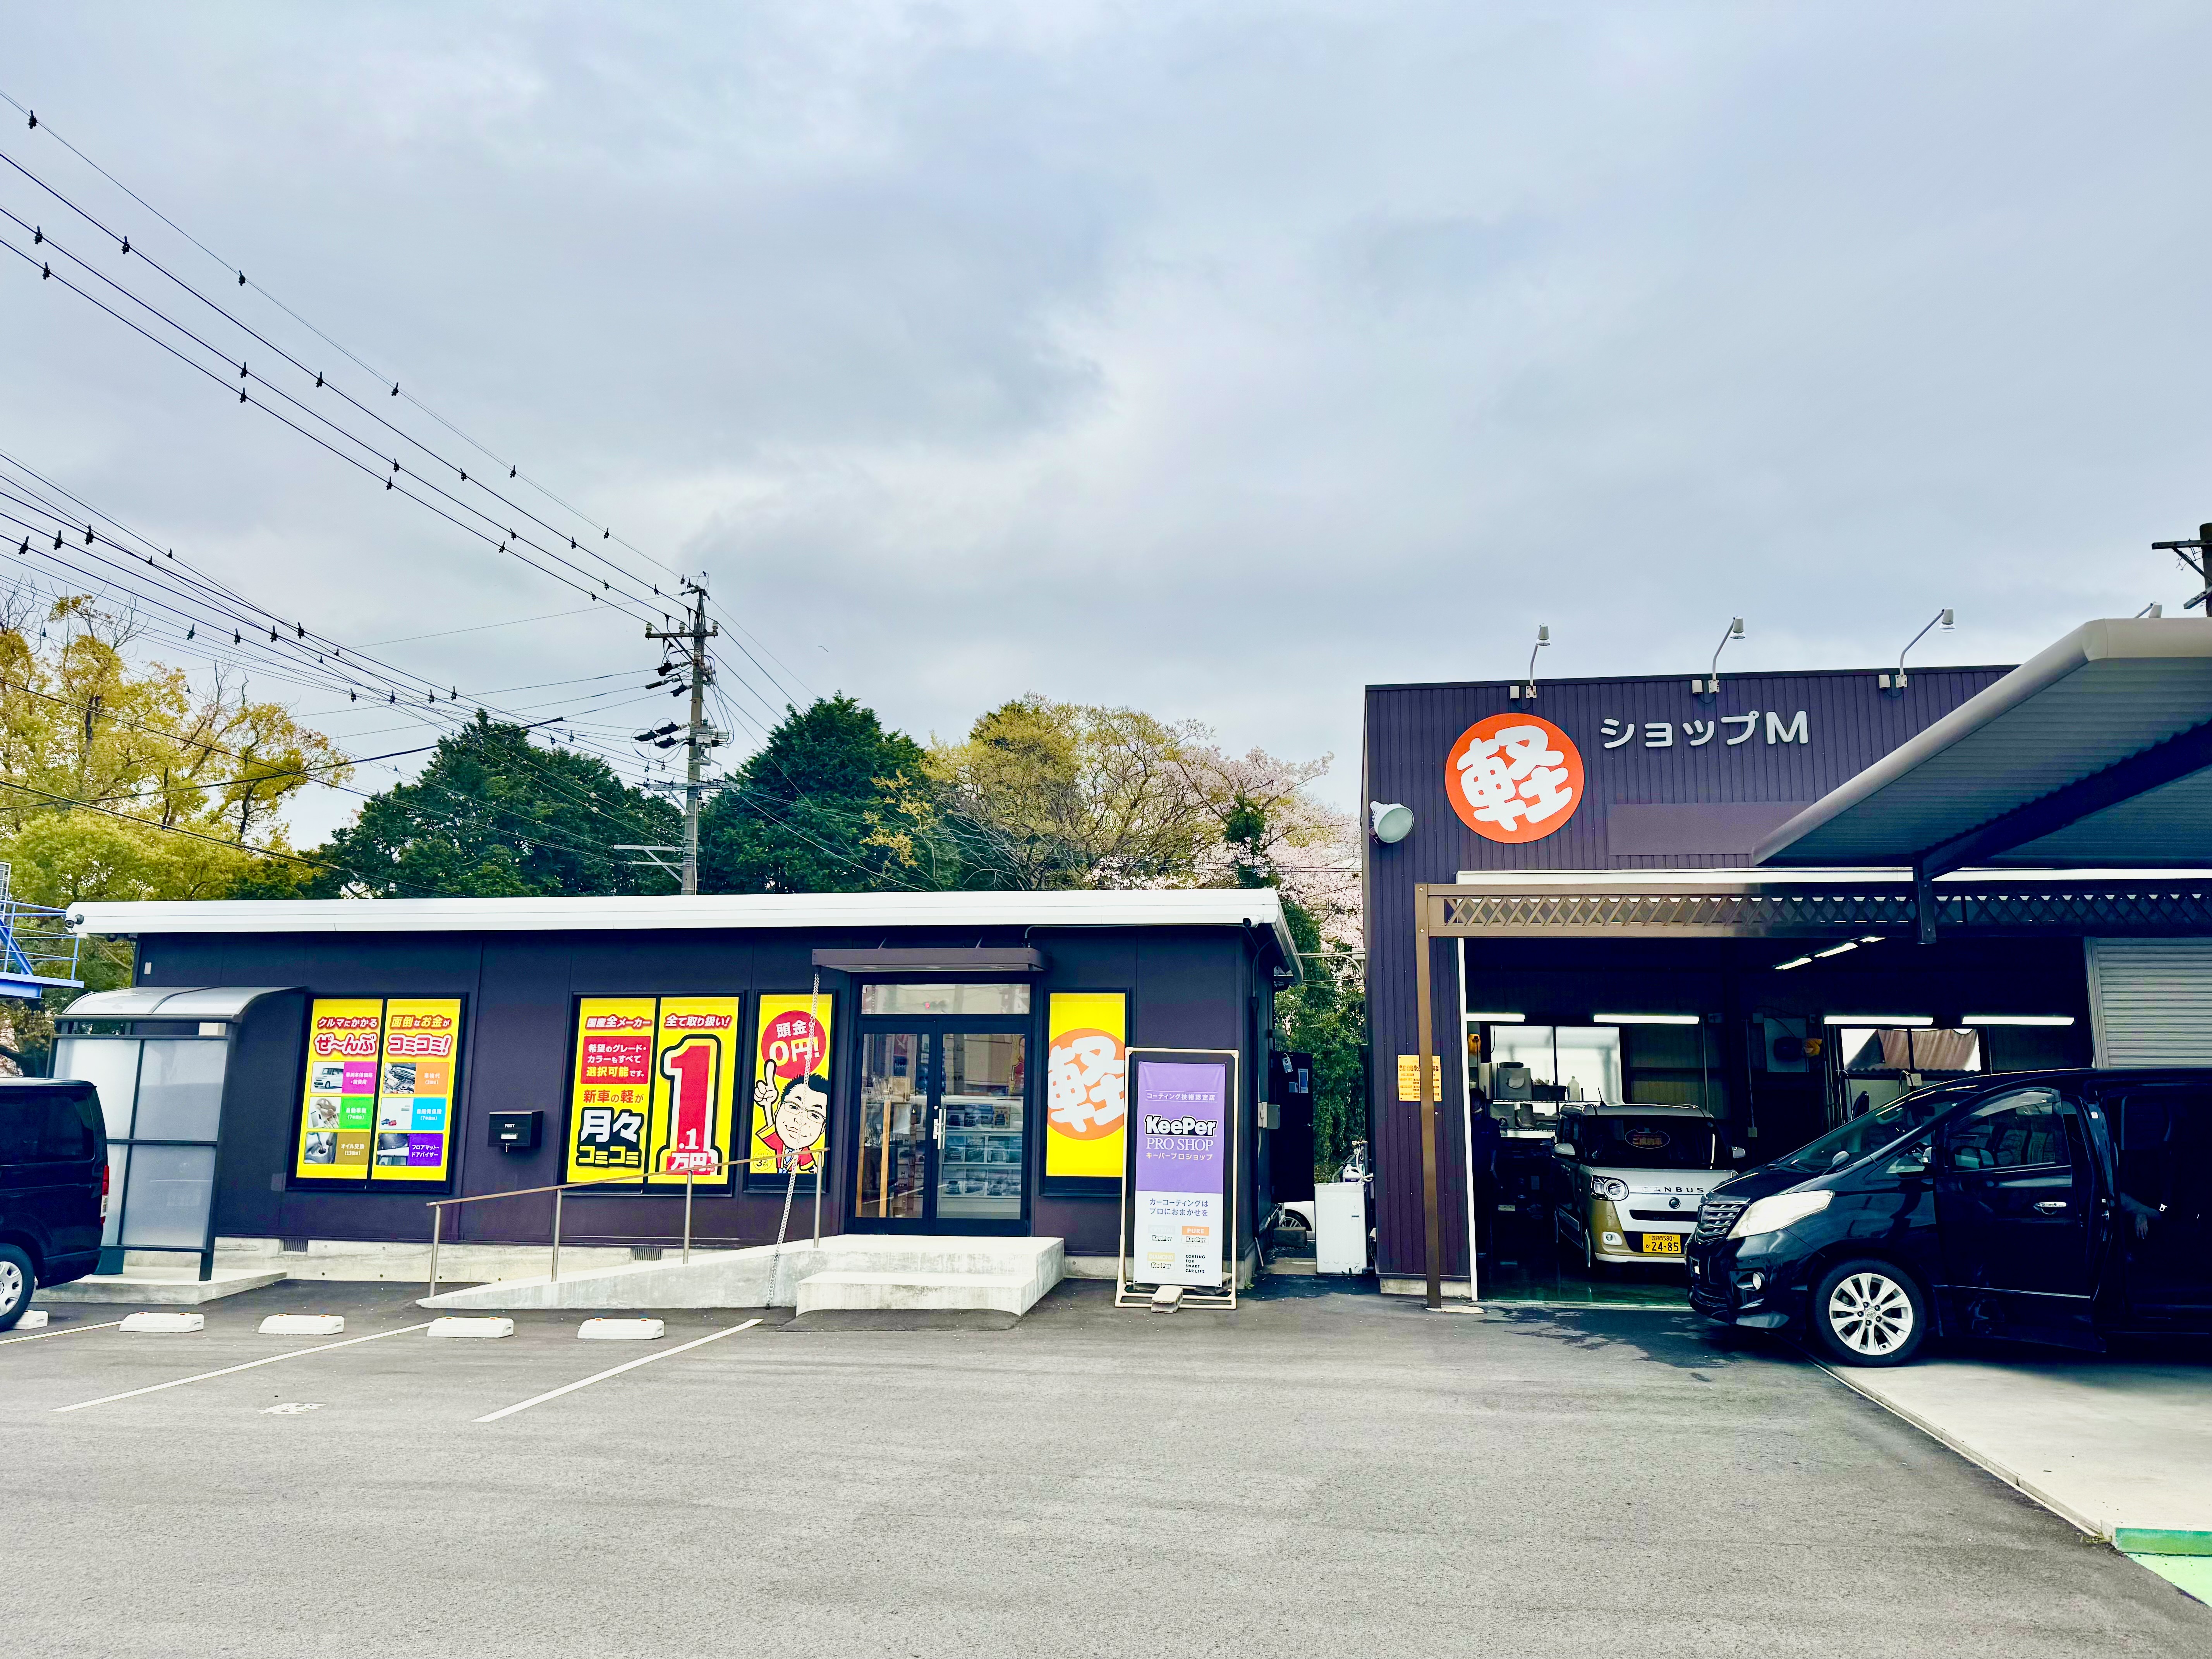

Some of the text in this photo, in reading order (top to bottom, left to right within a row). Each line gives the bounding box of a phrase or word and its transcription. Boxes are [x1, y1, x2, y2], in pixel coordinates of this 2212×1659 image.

[1600, 710, 1808, 749] ショップM
[1456, 724, 1573, 831] 軽
[319, 1018, 377, 1027] クルマにかかる
[392, 1016, 450, 1027] 面倒なお金が
[586, 1015, 651, 1028] 国産全メーカー
[665, 1015, 730, 1027] 全て取り扱い!
[776, 1019, 807, 1039] 頭金
[389, 1036, 450, 1054] コミコミ!
[588, 1044, 647, 1053] 希望のグレード・
[587, 1055, 642, 1063] カラーもすべて
[586, 1066, 644, 1077] 選択可能です。
[1048, 1036, 1125, 1132] 軽
[583, 1089, 644, 1103] 新車の軽が
[1146, 1092, 1216, 1101] コーティング技術認定店
[580, 1110, 642, 1143] 月々
[1144, 1115, 1218, 1136] KeePer
[1146, 1137, 1214, 1151] PRO SHOP
[578, 1146, 639, 1166] コミコミ
[1146, 1152, 1213, 1161] キーパープロショップ
[1149, 1198, 1209, 1207] カーコーティングは
[1149, 1207, 1208, 1217] プロにおまかせを
[1652, 1242, 1679, 1252] 24-85
